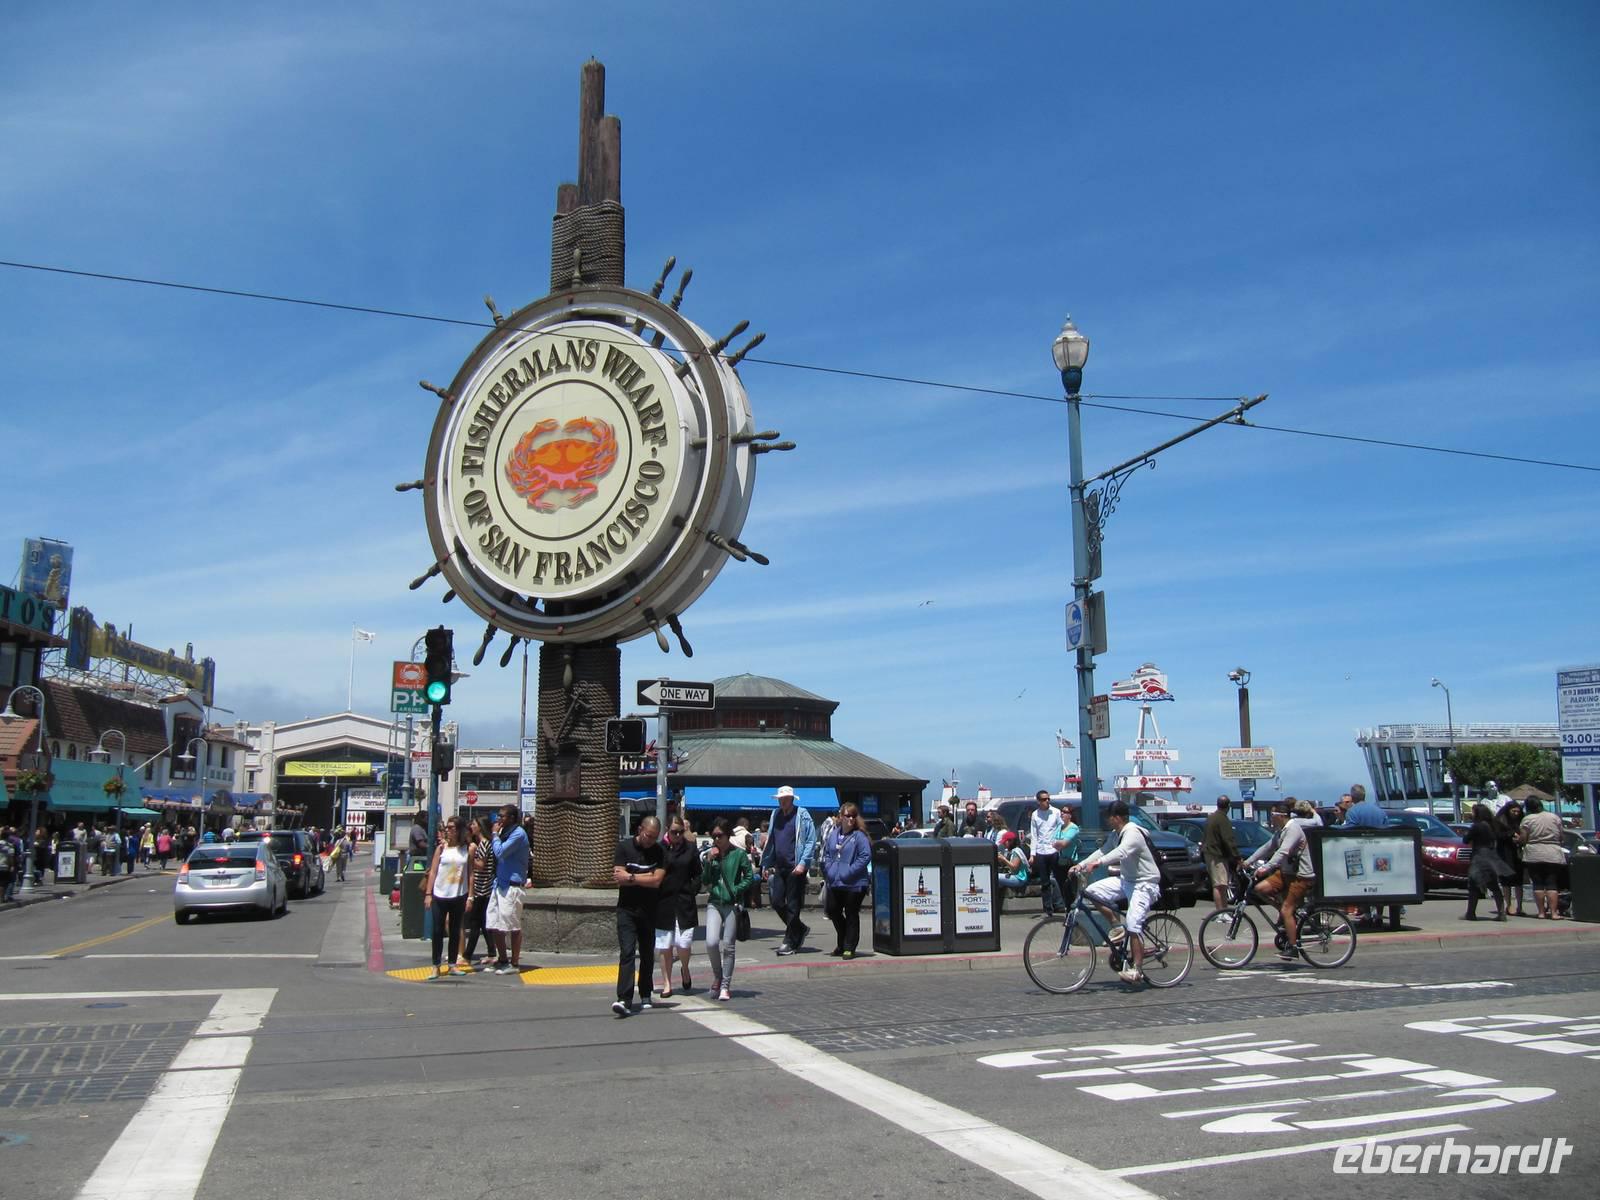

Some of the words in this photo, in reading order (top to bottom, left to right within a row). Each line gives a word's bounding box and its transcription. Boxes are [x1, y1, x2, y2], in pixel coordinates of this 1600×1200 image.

[602, 344, 668, 449] WHARF
[463, 489, 494, 530] OF
[479, 524, 530, 579] SAN
[533, 460, 666, 585] FRANCISCO
[660, 687, 681, 699] ONE
[684, 689, 706, 700] WAY
[1562, 733, 1593, 744] $3.00
